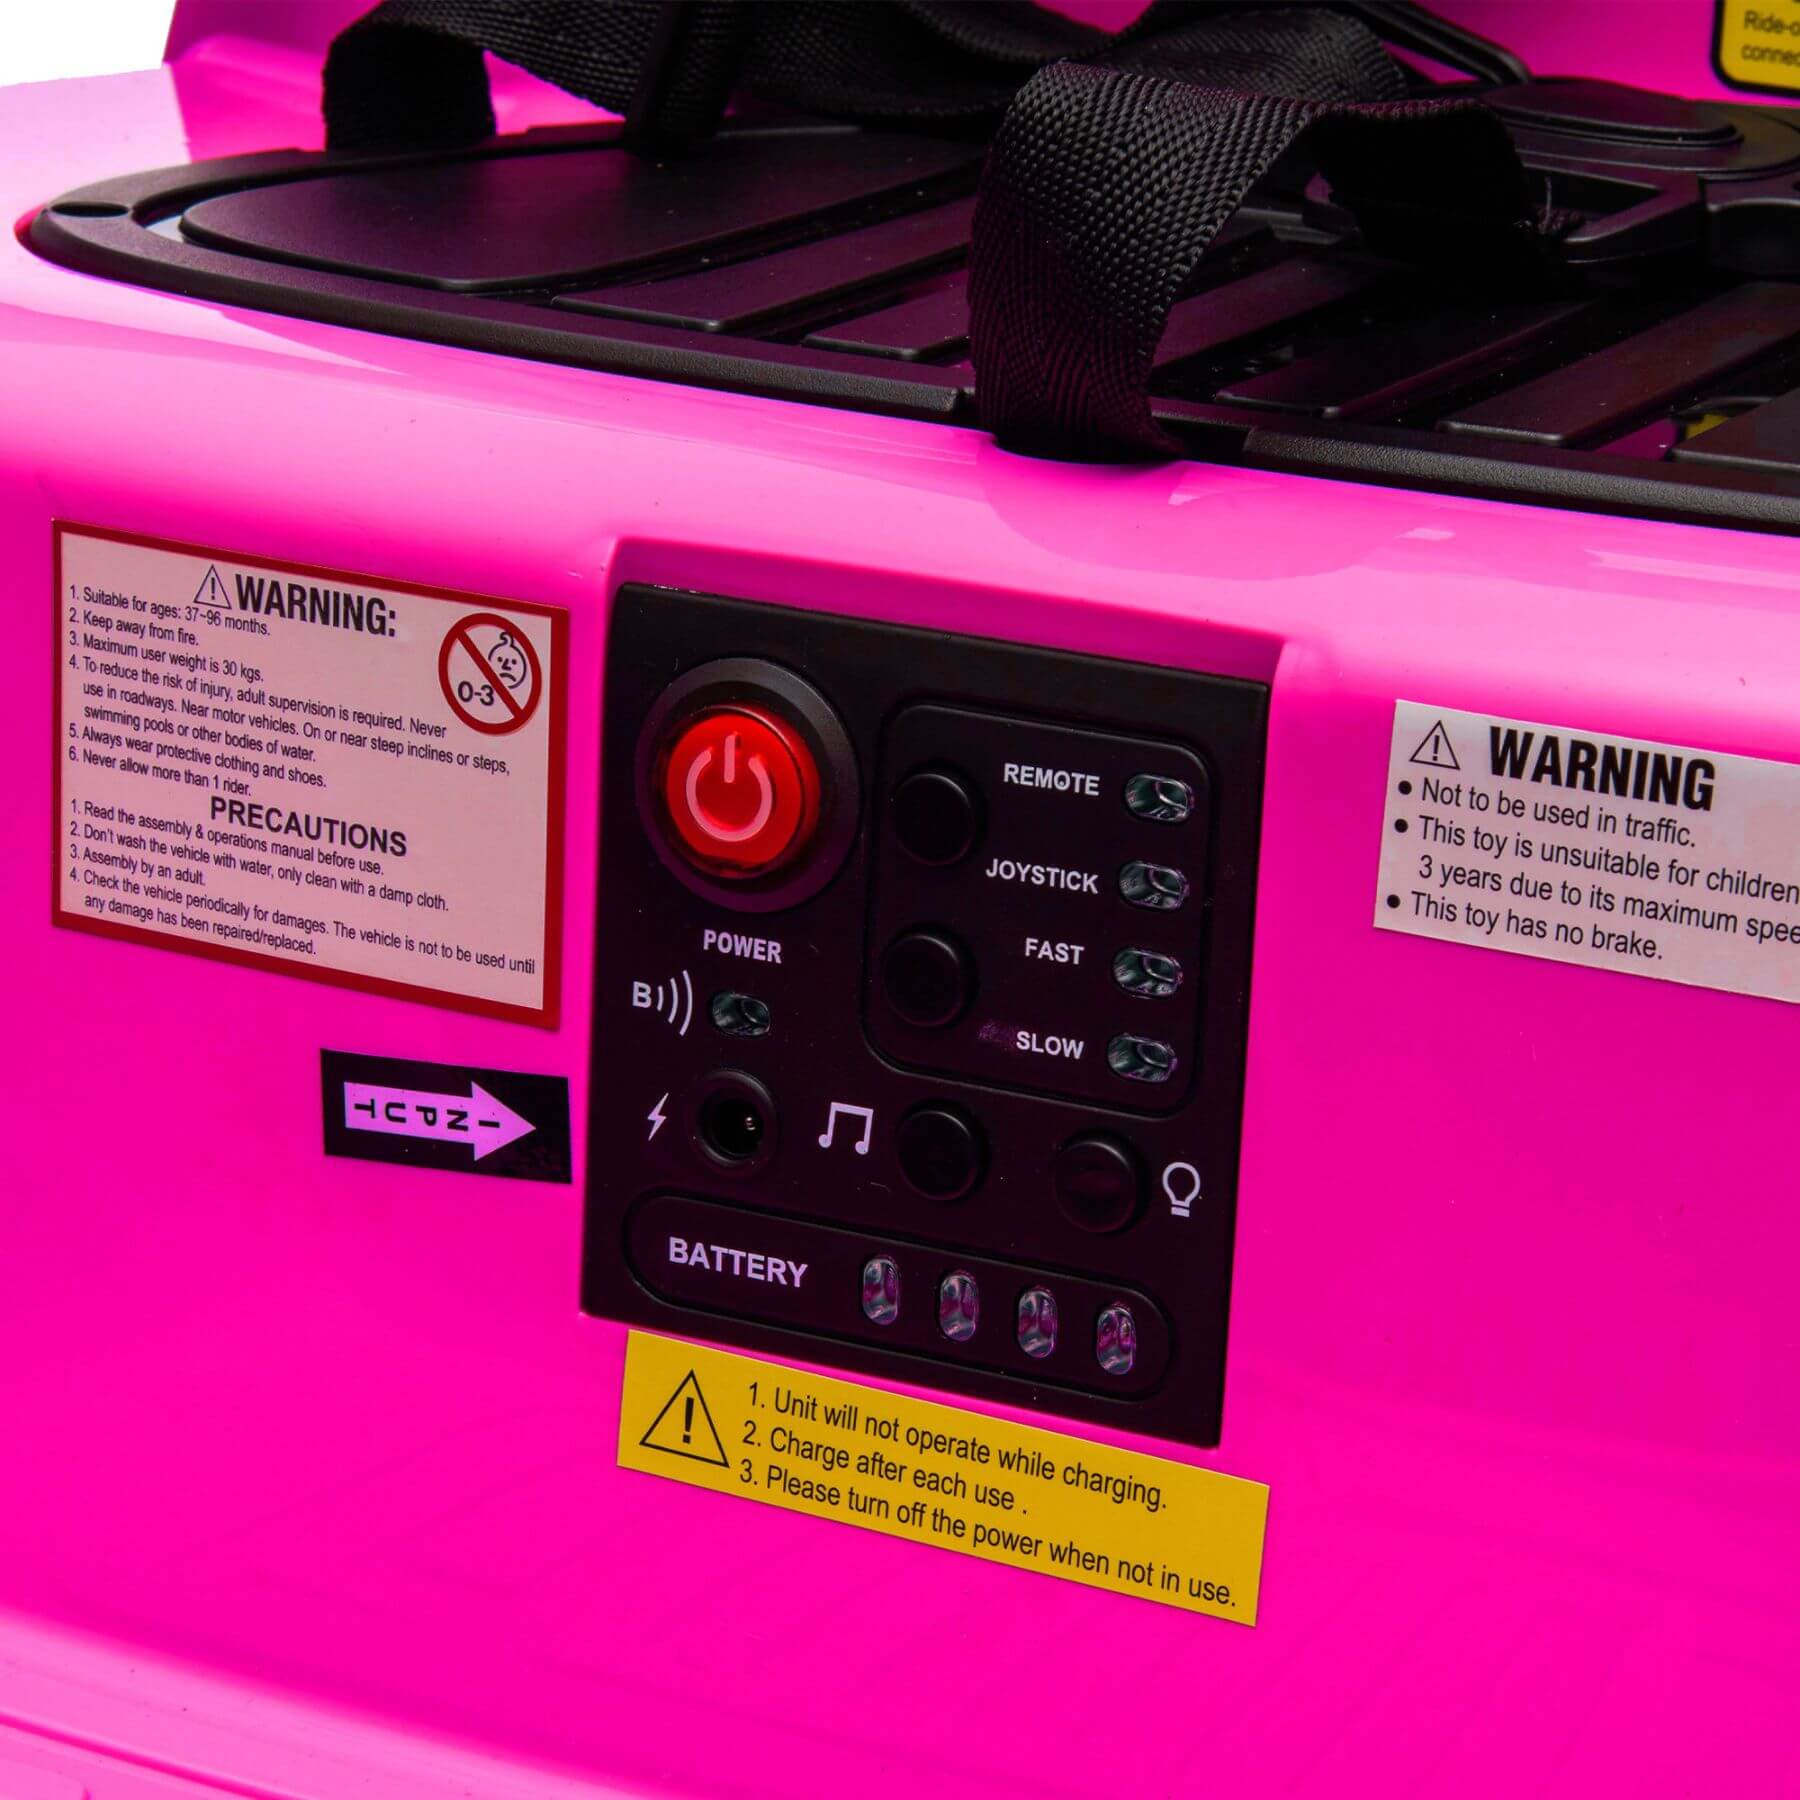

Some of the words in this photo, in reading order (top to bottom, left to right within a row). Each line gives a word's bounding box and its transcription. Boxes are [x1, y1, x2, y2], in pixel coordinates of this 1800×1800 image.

[83, 586, 130, 609] Suitable
[132, 595, 148, 613] for
[150, 602, 181, 620] ages:
[185, 605, 222, 627] 37~96
[225, 616, 270, 636] months.
[83, 609, 113, 633] Keep
[116, 619, 146, 639] away
[149, 622, 175, 642] from
[177, 627, 199, 646] fire.
[235, 573, 397, 638] WARNING:
[83, 632, 138, 658] Maximum
[141, 647, 167, 663] user
[169, 652, 207, 673] weight
[222, 659, 237, 677] 30
[240, 662, 264, 684] kgs.
[82, 655, 98, 673] To
[100, 662, 139, 681] reduce
[141, 667, 160, 685] the
[162, 672, 183, 690] risk
[185, 677, 198, 692] of
[200, 678, 233, 703] injury,
[236, 687, 266, 706] adult
[268, 695, 336, 719] supervision
[352, 711, 405, 732] required.
[410, 717, 447, 739] Never
[457, 680, 495, 706] 0-3
[81, 725, 123, 750] Always
[125, 737, 154, 753] wear
[156, 743, 212, 765] protective
[214, 752, 260, 778] clothing
[262, 764, 285, 780] and
[288, 767, 327, 788] shoes.
[84, 683, 104, 698] use
[120, 690, 177, 714] roadways.
[181, 698, 210, 718] Near
[212, 708, 246, 725] motor
[248, 713, 299, 736] vehicles.
[303, 721, 321, 740] On
[324, 729, 337, 742] or
[340, 732, 368, 748] near
[370, 735, 404, 758] steep
[407, 740, 454, 764] inclines
[456, 753, 470, 767] or
[472, 754, 510, 776] steps,
[84, 705, 141, 732] swimming
[144, 717, 175, 735] pools
[177, 724, 190, 737] or
[191, 725, 222, 744] other
[225, 730, 264, 752] bodies
[280, 744, 316, 762] water.
[83, 748, 117, 769] Never
[119, 756, 149, 776] allow
[152, 765, 181, 782] more
[184, 768, 210, 788] than
[223, 777, 251, 797] rider.
[1003, 763, 1100, 795] REMOTE
[1490, 725, 1715, 812] WARNING
[84, 800, 115, 821] Read
[117, 808, 136, 826] the
[138, 815, 192, 841] assembly
[207, 829, 268, 853] operations
[271, 842, 314, 862] manual
[317, 847, 355, 870] before
[359, 859, 384, 876] use.
[211, 795, 407, 857] PRECAUTIONS
[1422, 776, 1462, 808] Not
[1469, 786, 1490, 812] to
[1497, 790, 1526, 818] be
[1533, 802, 1590, 829] used
[1597, 807, 1617, 834] in
[1625, 813, 1695, 848] traffic.
[82, 846, 138, 875] Assembly
[141, 858, 155, 879] by
[157, 865, 172, 879] an
[175, 867, 205, 886] adult.
[116, 833, 146, 851] wash
[149, 837, 168, 855] the
[170, 844, 210, 864] vehicle
[213, 852, 237, 869] with
[239, 859, 274, 879] water,
[277, 866, 302, 886] only
[305, 870, 337, 890] clean
[340, 877, 365, 895] with
[379, 883, 414, 907] damp
[417, 891, 449, 911] cloth.
[985, 858, 1099, 894] JOYSTICK
[1420, 814, 1465, 847] This
[1473, 826, 1508, 860] toy
[1515, 832, 1533, 858] is
[1541, 842, 1660, 881] unsuitable
[1668, 858, 1700, 887] for
[1706, 867, 1800, 905] children
[84, 869, 120, 890] Check
[122, 877, 140, 895] the
[143, 884, 183, 904] vehicle
[186, 894, 250, 921] periodically
[253, 904, 269, 922] for
[272, 909, 329, 934] damages.
[333, 920, 356, 940] The
[359, 928, 402, 949] vehicle
[418, 941, 438, 956] not
[440, 942, 453, 959] to
[456, 944, 472, 963] be
[475, 952, 506, 969] used
[509, 958, 535, 974] until
[84, 895, 106, 914] any
[108, 897, 154, 923] damage
[157, 907, 178, 926] has
[181, 912, 209, 933] been
[212, 922, 316, 955] repaired/replaced.
[1412, 890, 1457, 922] This
[1465, 902, 1500, 936] toy
[1506, 908, 1547, 939] has
[1555, 923, 1584, 945] no
[1591, 923, 1662, 960] brake.
[1419, 854, 1433, 879] 3
[1441, 863, 1502, 892] years
[1510, 871, 1553, 901] due
[1561, 880, 1582, 906] to
[1589, 884, 1615, 912] its
[1623, 896, 1738, 934] maximum
[702, 930, 782, 963] POWER
[1025, 939, 1084, 964] FAST
[1016, 1031, 1084, 1058] SLOW
[354, 1098, 500, 1132] INPUT
[668, 1236, 807, 1288] BATTERY
[770, 1426, 850, 1472] Charge
[856, 1451, 908, 1483] after
[913, 1469, 966, 1499] each
[775, 1387, 818, 1422] Unit
[824, 1404, 858, 1432] will
[865, 1416, 900, 1443] not
[906, 1427, 990, 1464] operate
[998, 1447, 1055, 1480] while
[1063, 1462, 1166, 1513] charging.
[767, 1464, 841, 1506] Please
[848, 1486, 889, 1519] turn
[897, 1501, 926, 1528] off
[932, 1507, 966, 1538] the
[973, 1523, 1043, 1557] power
[1049, 1540, 1109, 1575] when
[1118, 1560, 1154, 1587] not
[1161, 1564, 1180, 1593] in
[1189, 1578, 1235, 1607] use.
